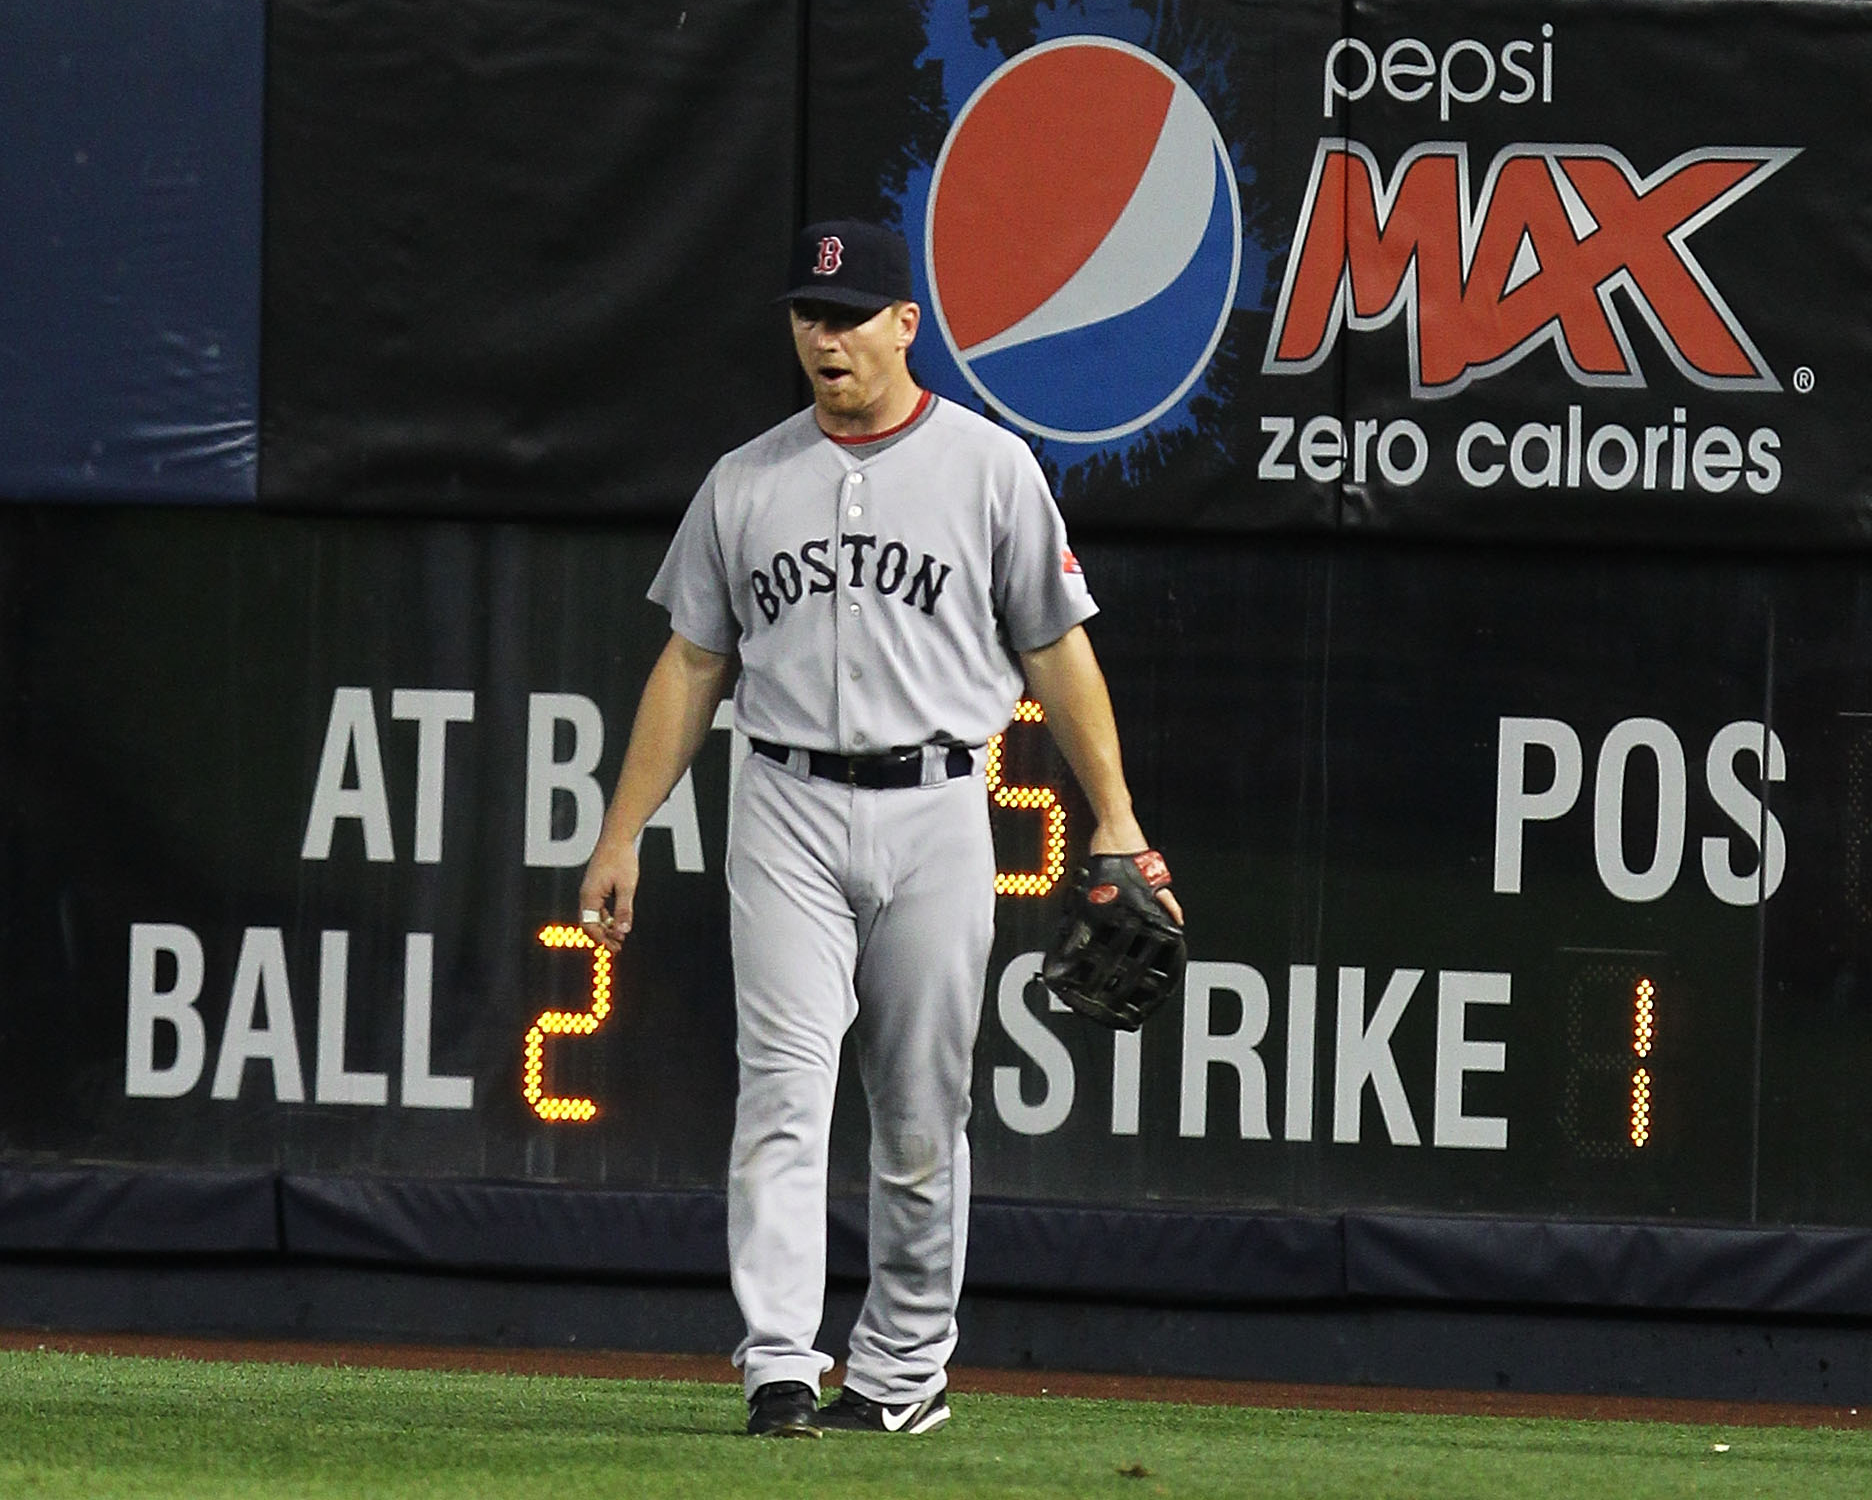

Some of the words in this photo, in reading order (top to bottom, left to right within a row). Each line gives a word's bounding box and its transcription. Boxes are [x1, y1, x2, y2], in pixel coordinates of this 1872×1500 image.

[1322, 23, 1553, 121] pepsi
[813, 236, 843, 276] B
[1261, 138, 1806, 399] MAX
[1258, 417, 1428, 486] zero
[1456, 405, 1783, 495] calories
[751, 534, 952, 625] BOSTON
[301, 687, 475, 863] AT
[523, 692, 752, 873] BA
[1493, 716, 1786, 906] POS
[125, 923, 474, 1109] BALL
[523, 925, 613, 1123] 2
[1630, 978, 1654, 1148] 1
